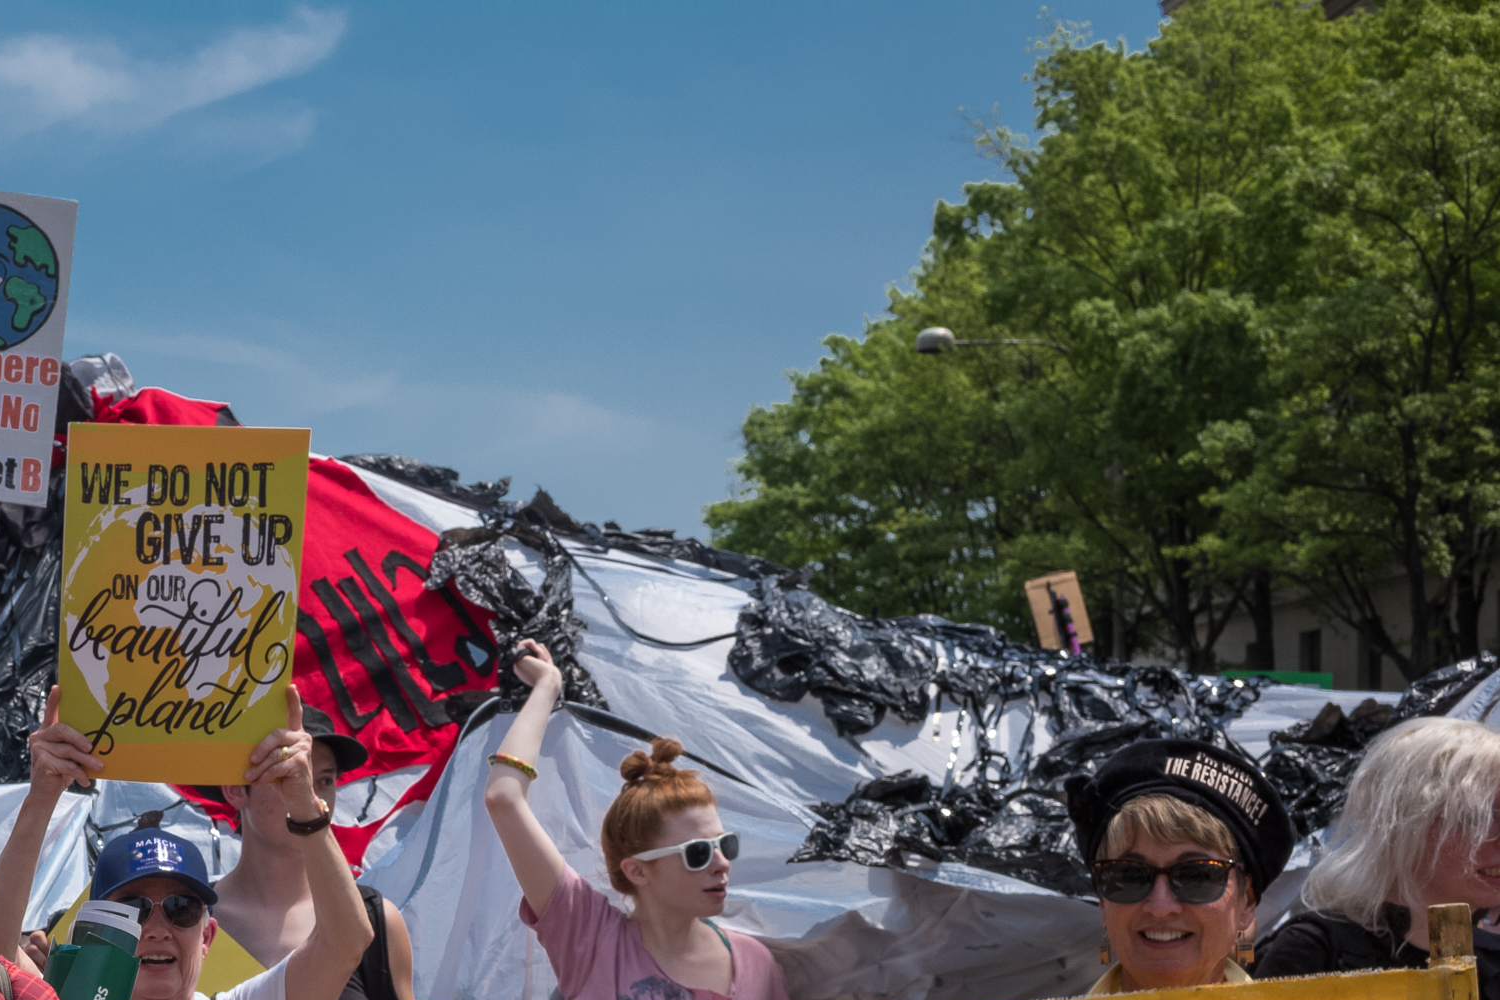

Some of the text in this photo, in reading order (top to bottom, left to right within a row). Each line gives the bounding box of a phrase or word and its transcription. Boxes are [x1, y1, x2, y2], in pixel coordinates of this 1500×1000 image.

[0, 394, 40, 433] No
[21, 457, 42, 492] B
[81, 462, 275, 507] WE DO NOT
[135, 512, 293, 567] GIVE UP
[112, 574, 186, 602] ON OUR
[69, 578, 289, 689] beautiful
[84, 658, 248, 756] planet
[1164, 756, 1268, 826] THE RESISTANCE!
[135, 837, 177, 849] MARCH
